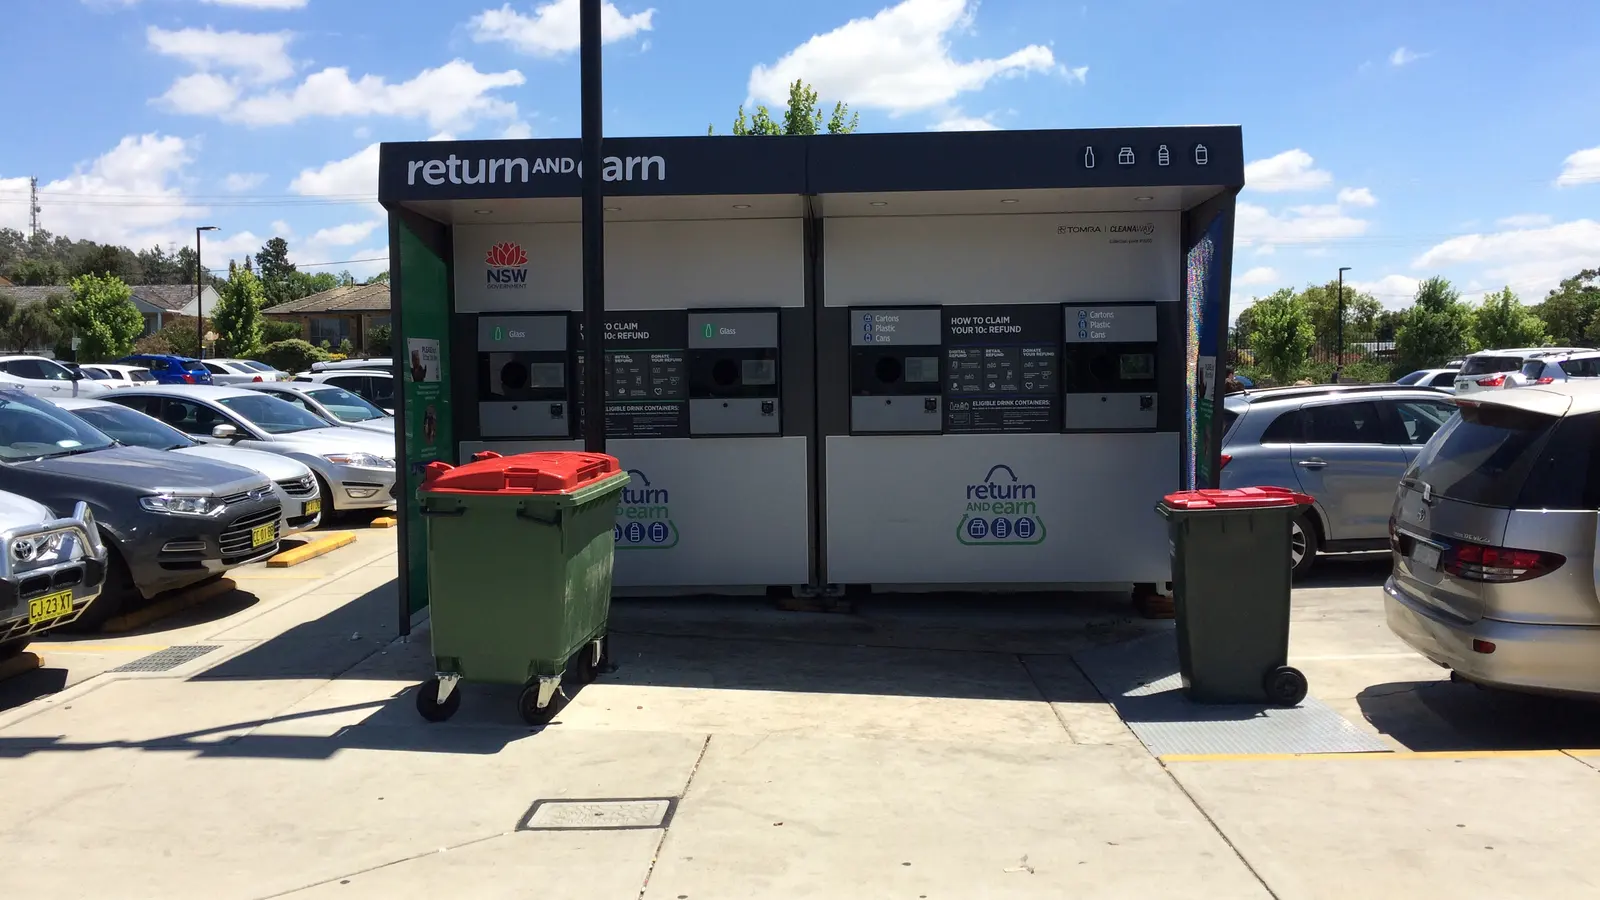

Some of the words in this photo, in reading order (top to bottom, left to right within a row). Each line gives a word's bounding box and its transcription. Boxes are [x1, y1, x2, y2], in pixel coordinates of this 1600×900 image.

[407, 154, 529, 186] return
[532, 157, 575, 174] AND
[577, 155, 666, 182] arn
[1109, 223, 1154, 235] CLEANAWAY
[487, 269, 528, 283] NSW
[875, 315, 900, 323] Cartons
[1089, 311, 1115, 319] Cartons
[950, 317, 971, 325] HOW
[973, 316, 984, 324] TO
[984, 316, 1010, 324] CLAIM
[1090, 321, 1111, 329] Plastic
[604, 322, 612, 331] O
[613, 322, 638, 330] CLAIM
[719, 327, 736, 335] Glass
[875, 324, 896, 332] Plastic
[951, 326, 974, 334] YOUR
[975, 326, 988, 334] 10c
[989, 325, 1022, 333] REFUND
[508, 330, 526, 338] Glass
[617, 331, 650, 340] REFUND
[875, 334, 891, 342] Cans
[1090, 331, 1106, 339] Cans
[619, 486, 669, 504] turn
[966, 482, 1036, 500] return
[626, 505, 669, 519] earn
[965, 502, 991, 511] AND
[991, 501, 1037, 515] earn
